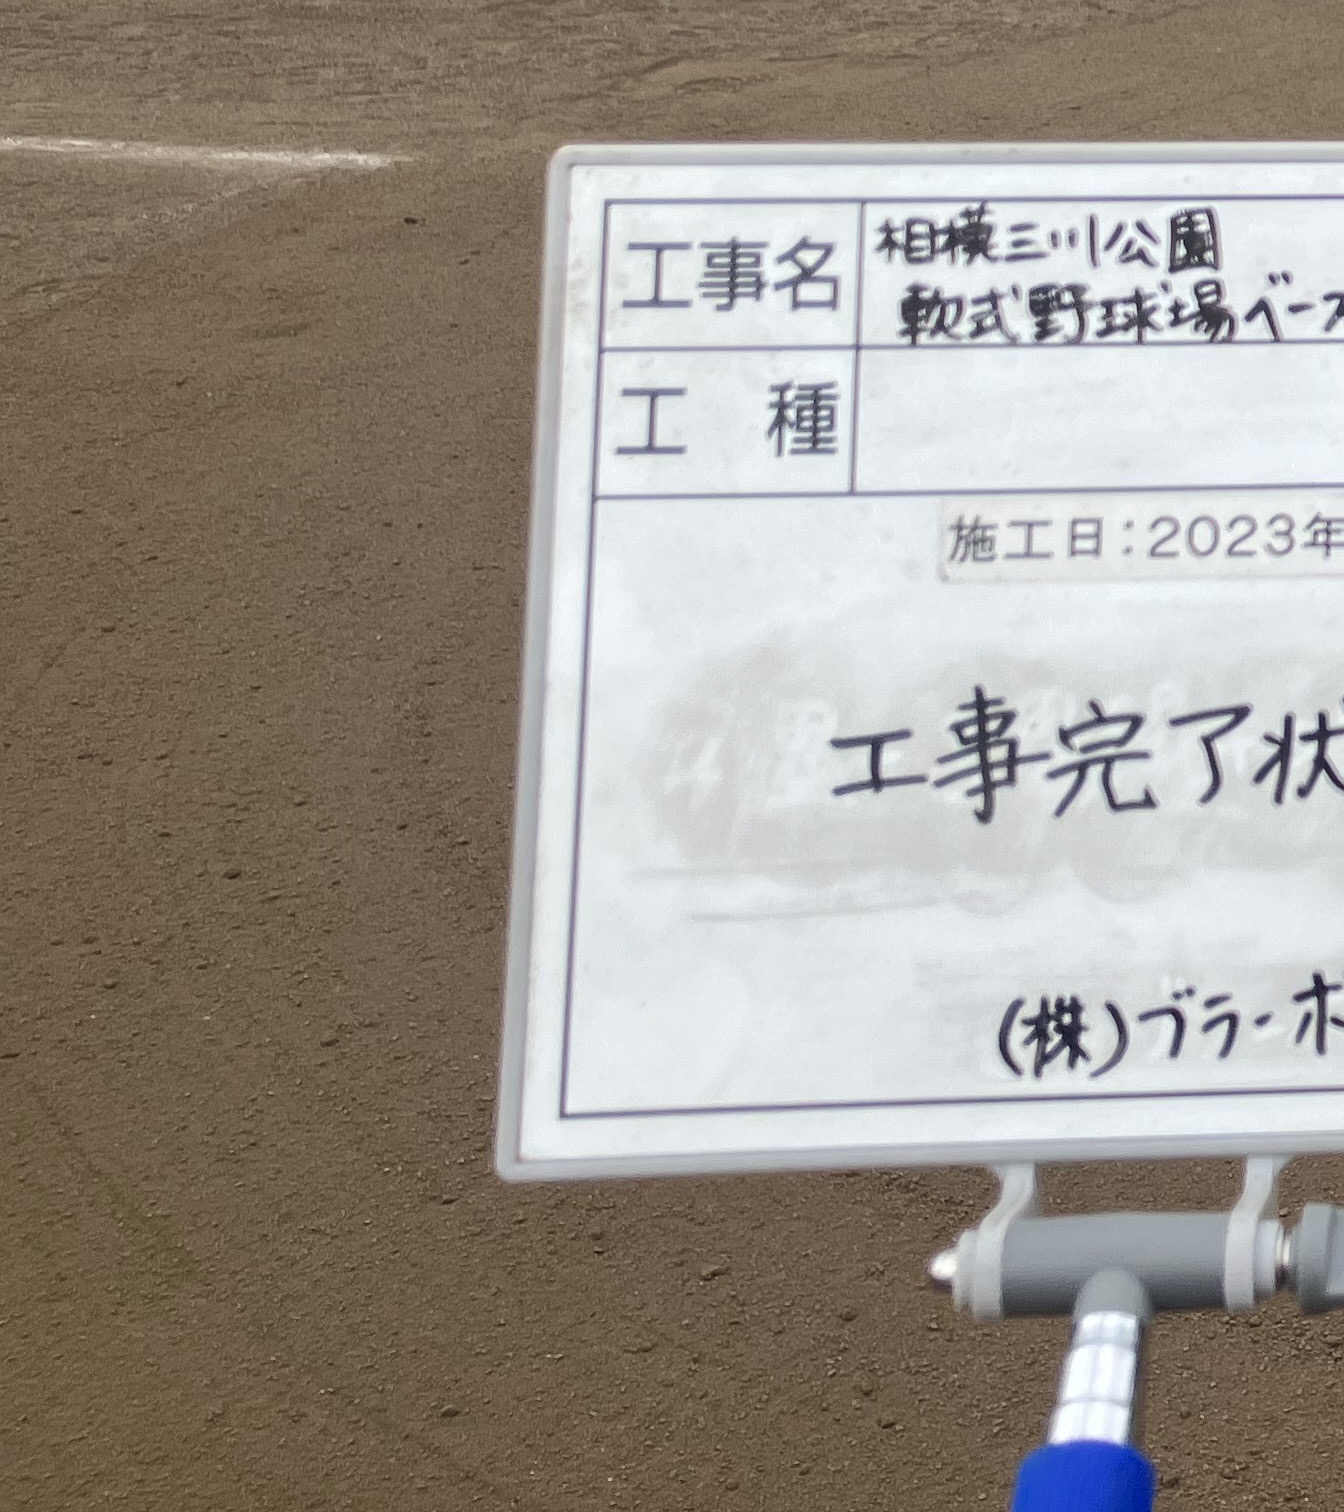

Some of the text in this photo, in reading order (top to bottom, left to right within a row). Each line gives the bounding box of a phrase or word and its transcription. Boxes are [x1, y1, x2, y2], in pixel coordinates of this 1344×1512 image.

[875, 200, 1222, 273] 相模三川公園
[621, 237, 841, 313] 工事名
